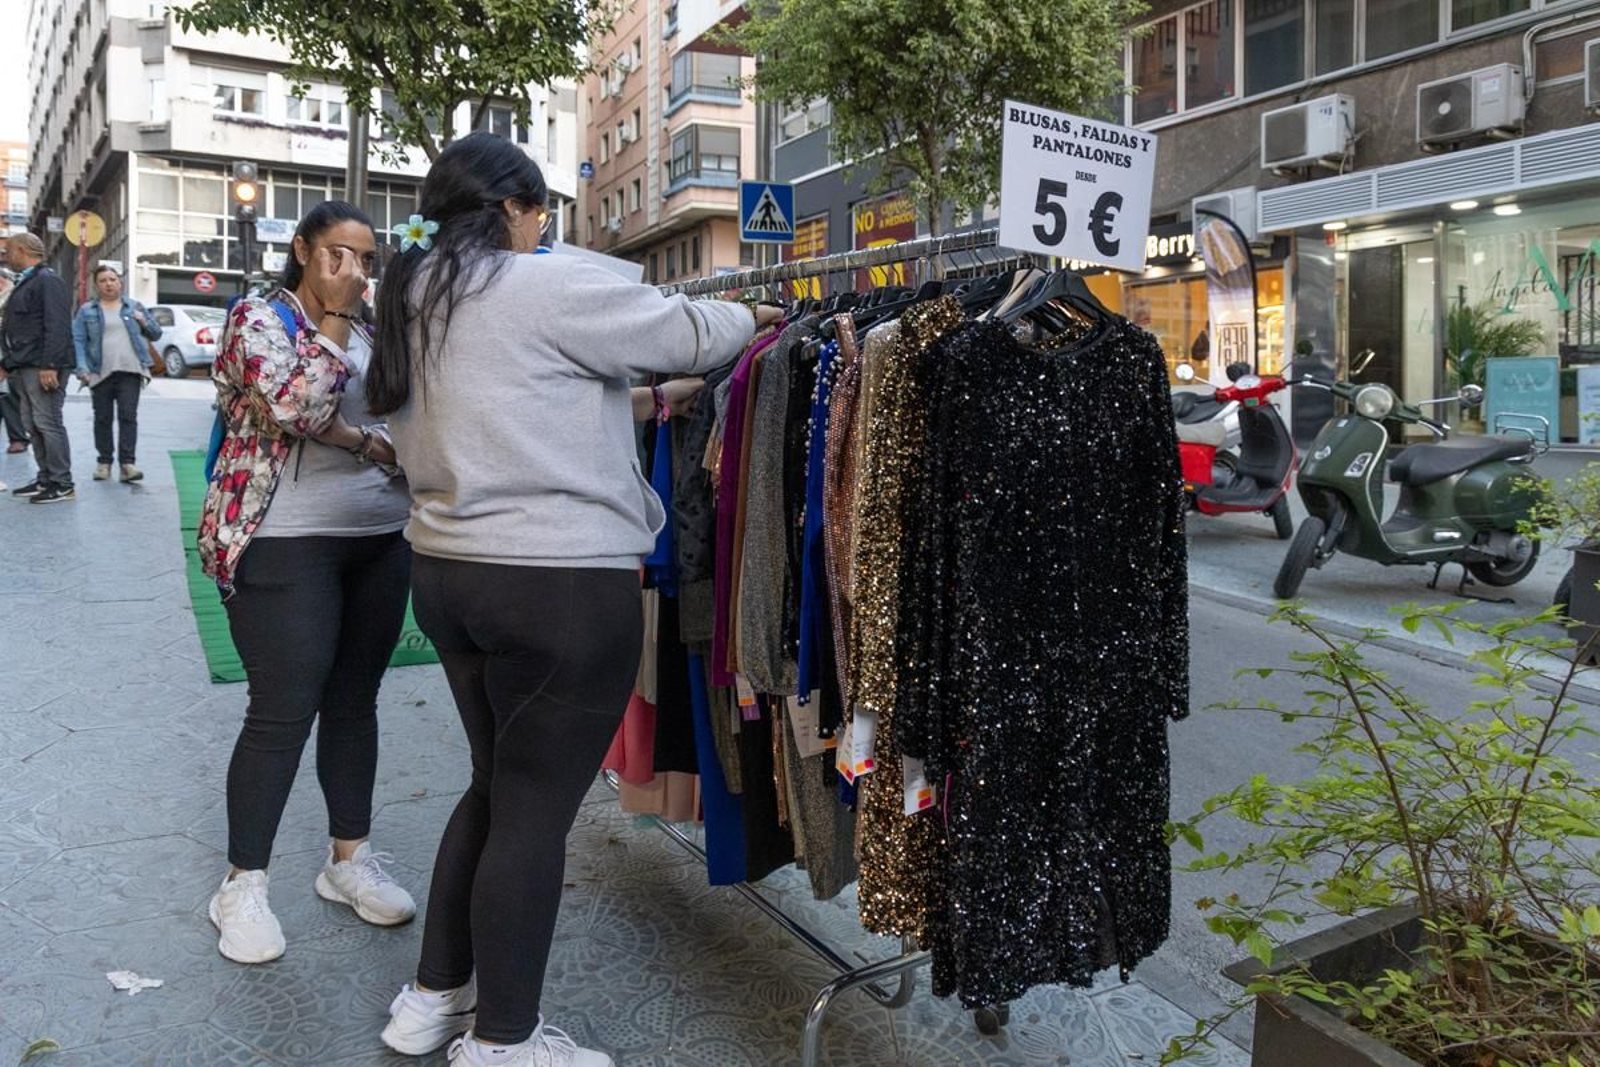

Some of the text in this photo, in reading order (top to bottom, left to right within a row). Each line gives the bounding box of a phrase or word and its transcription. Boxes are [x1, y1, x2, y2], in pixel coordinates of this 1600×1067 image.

[1032, 134, 1132, 168] PANTALONES
[1081, 124, 1138, 150] FALDAS
[1139, 139, 1151, 152] Y
[1075, 170, 1097, 183] DESDE
[855, 210, 874, 235] NO
[1032, 177, 1123, 257] 5 €
[1147, 233, 1195, 258] Berry
